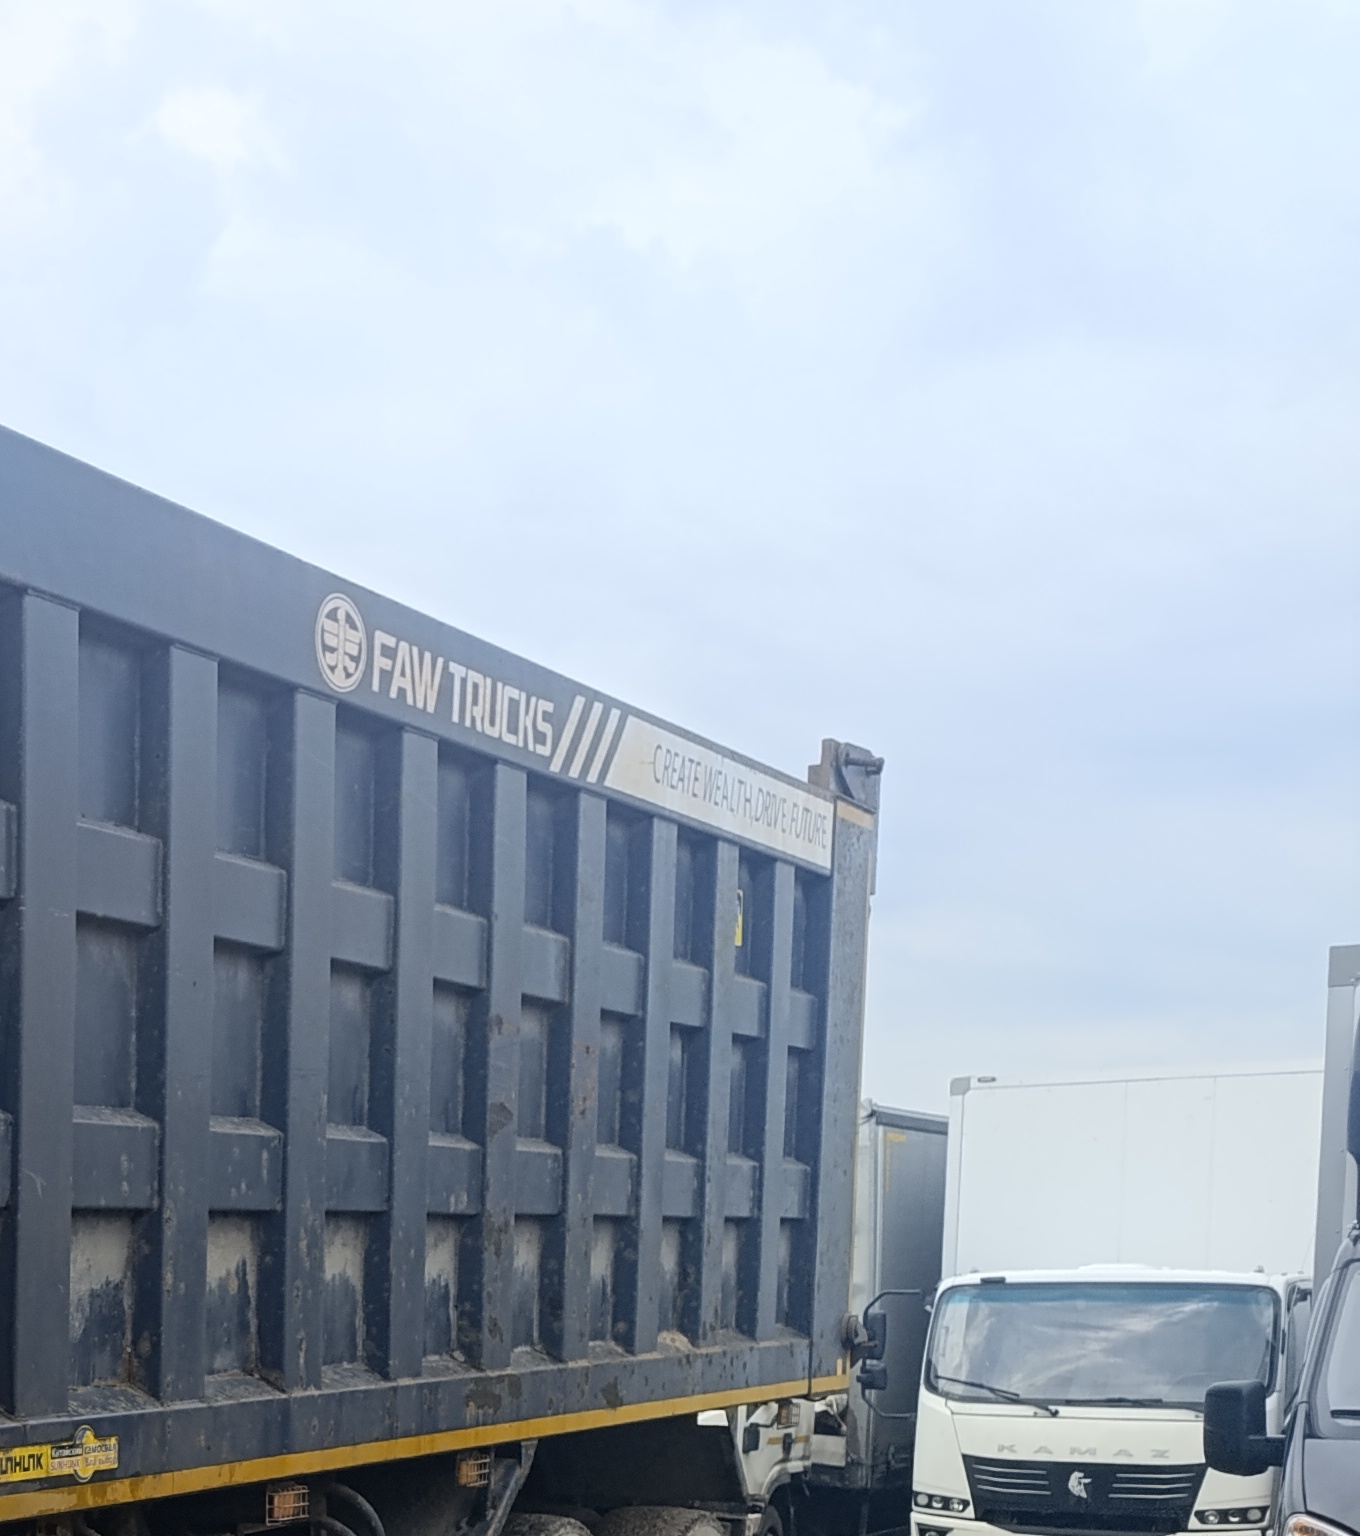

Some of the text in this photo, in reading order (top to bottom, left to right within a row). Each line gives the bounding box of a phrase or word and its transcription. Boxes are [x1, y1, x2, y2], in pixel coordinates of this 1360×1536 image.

[372, 630, 554, 757] FAW TRUCKS
[653, 744, 701, 798] CREATE
[789, 802, 827, 849] FUTURE
[997, 1444, 1170, 1459] KAMAZ
